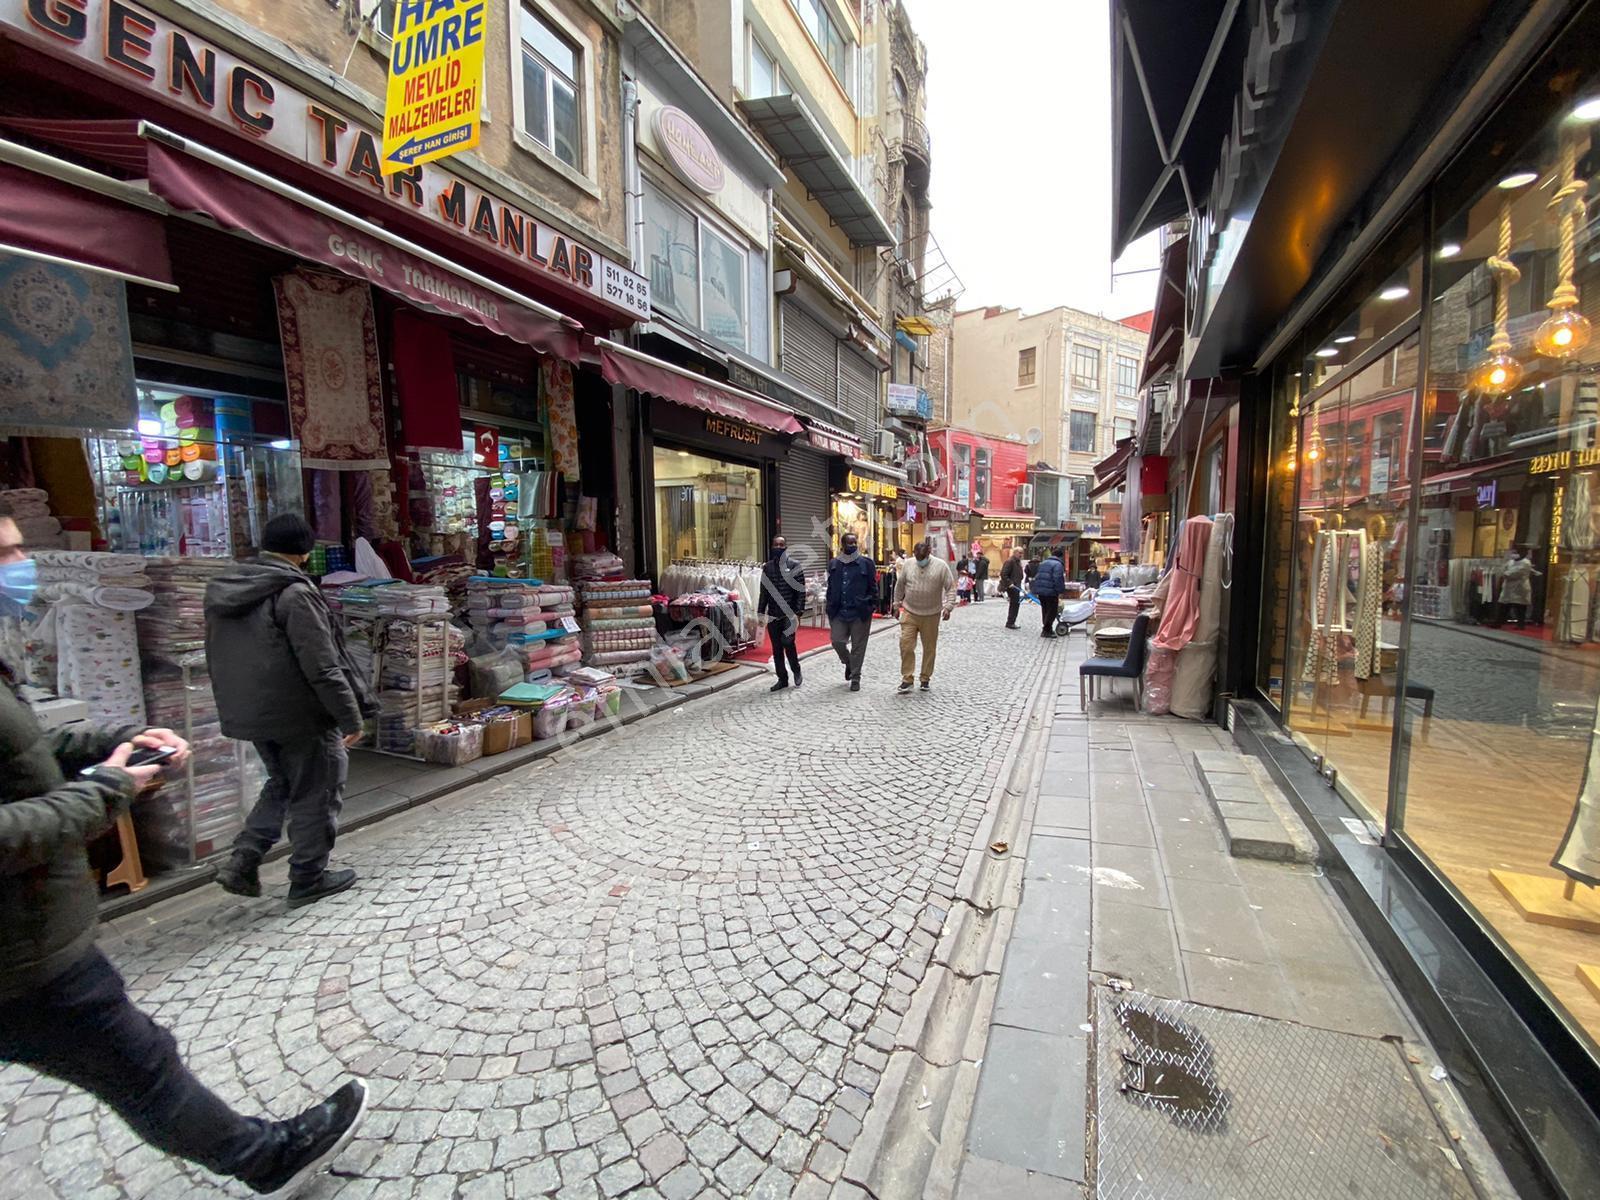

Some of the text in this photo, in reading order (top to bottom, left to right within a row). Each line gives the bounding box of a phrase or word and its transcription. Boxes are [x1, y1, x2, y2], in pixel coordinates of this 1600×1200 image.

[393, 2, 484, 76] UMRE
[404, 57, 462, 107] MEVLİD
[389, 80, 476, 140] MALZEMELERİ
[399, 128, 468, 160] ŞEREF HAN GİRİŞİ
[328, 234, 499, 321] GENÇ TARMANLAR
[606, 265, 620, 283] 511
[623, 275, 634, 290] 82
[606, 282, 623, 300] 527
[990, 520, 1034, 531] ÖZKAN HOME
